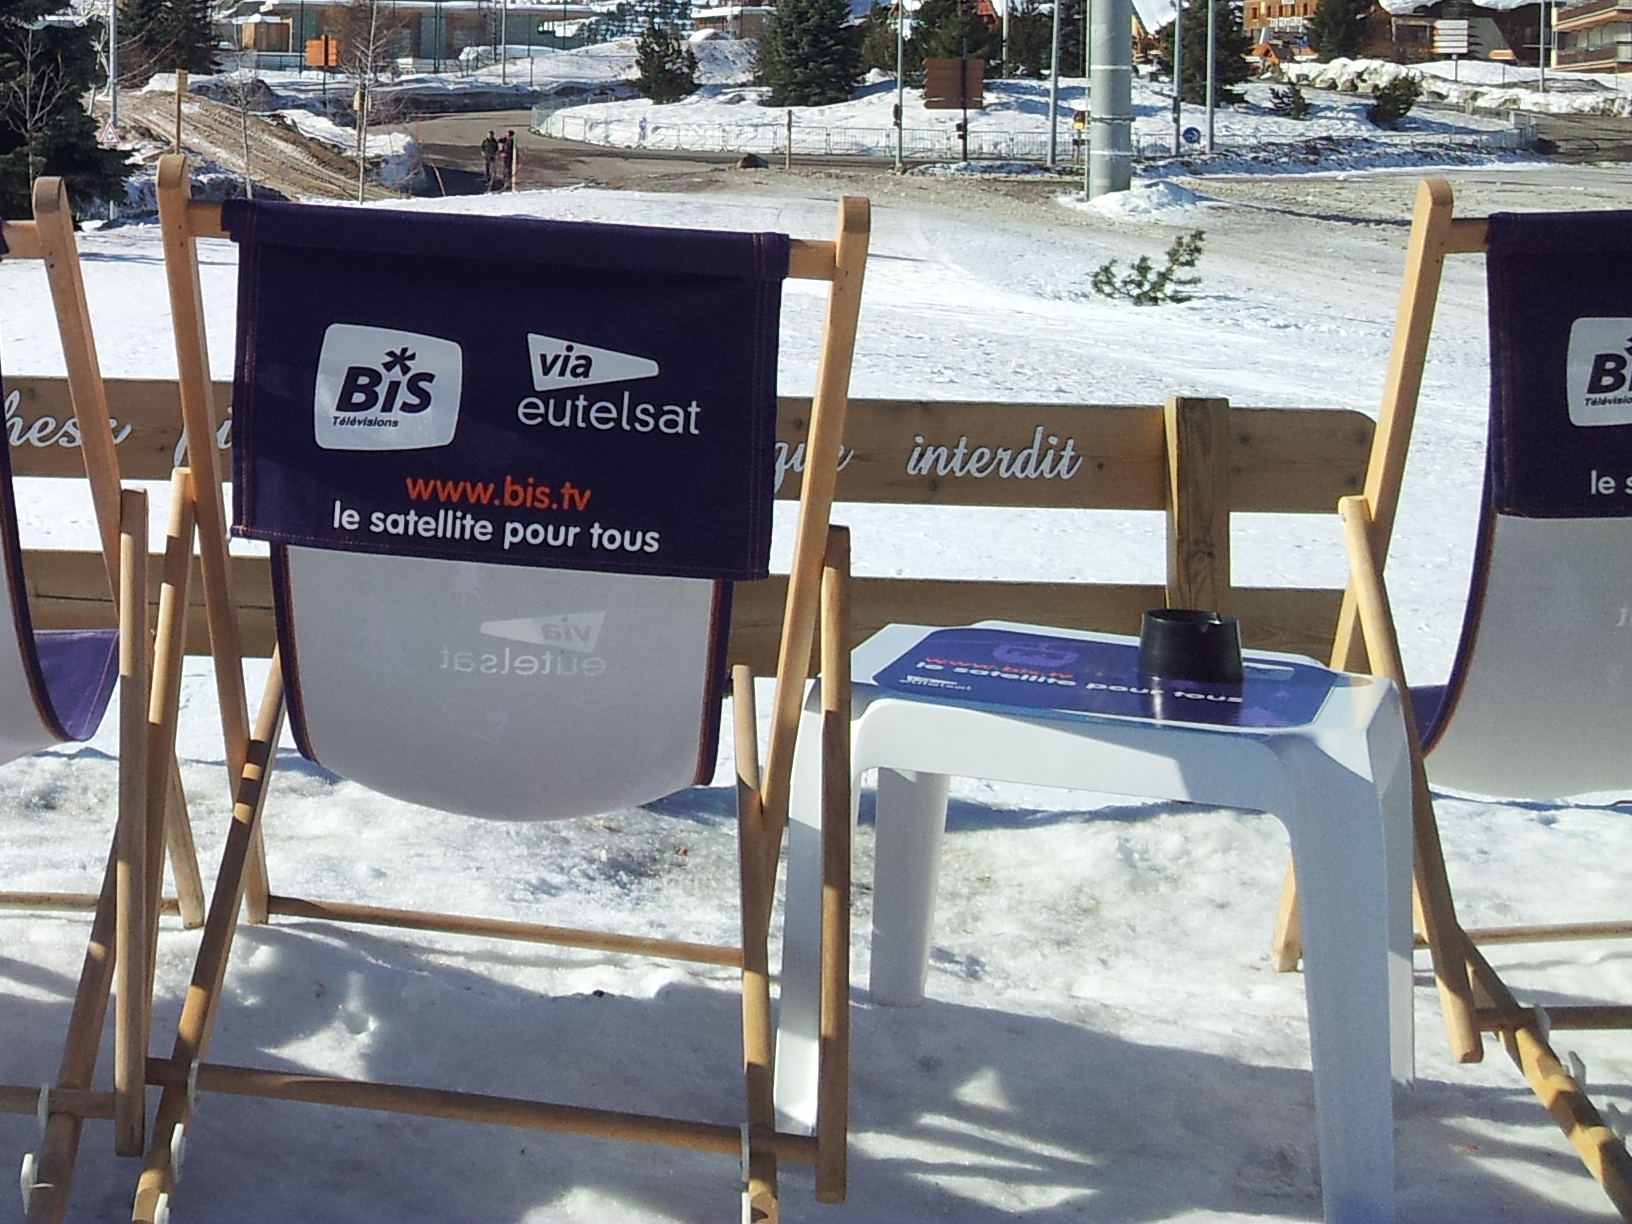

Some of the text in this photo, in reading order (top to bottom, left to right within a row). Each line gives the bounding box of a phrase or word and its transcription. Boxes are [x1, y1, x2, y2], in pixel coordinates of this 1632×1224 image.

[538, 344, 594, 379] via
[332, 415, 399, 428] Télévisions
[517, 391, 702, 436] eutelsat
[905, 424, 1084, 480] interdit
[405, 475, 593, 511] www.bis.tv
[1590, 469, 1617, 495] le
[332, 499, 661, 553] le satellite pour tous
[953, 667, 1077, 687] satellite
[1085, 682, 1165, 695] pour
[1172, 689, 1244, 704] tous
